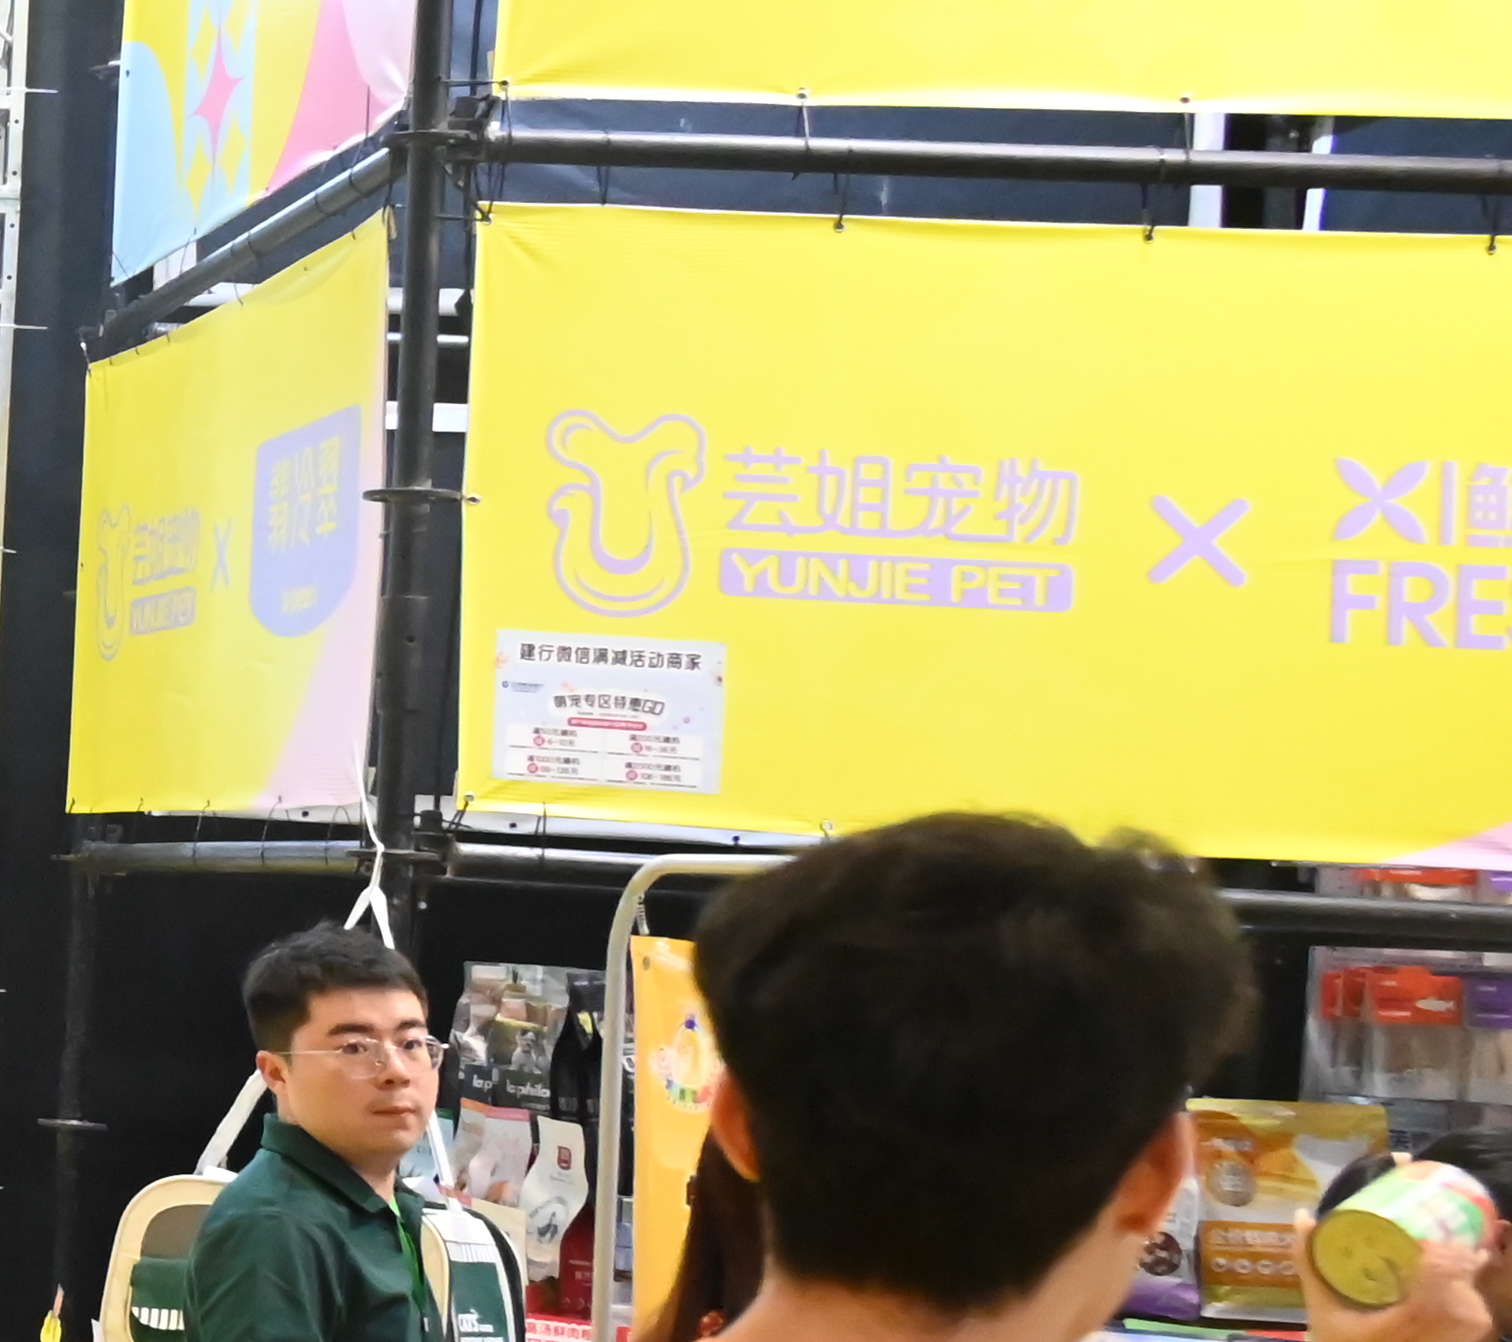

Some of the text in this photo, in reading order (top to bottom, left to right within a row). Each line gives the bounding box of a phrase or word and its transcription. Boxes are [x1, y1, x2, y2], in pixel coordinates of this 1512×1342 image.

[722, 447, 1081, 547] 芸姐宠物
[726, 553, 1063, 609] YUNJIE PET
[1330, 558, 1512, 650] FRE
